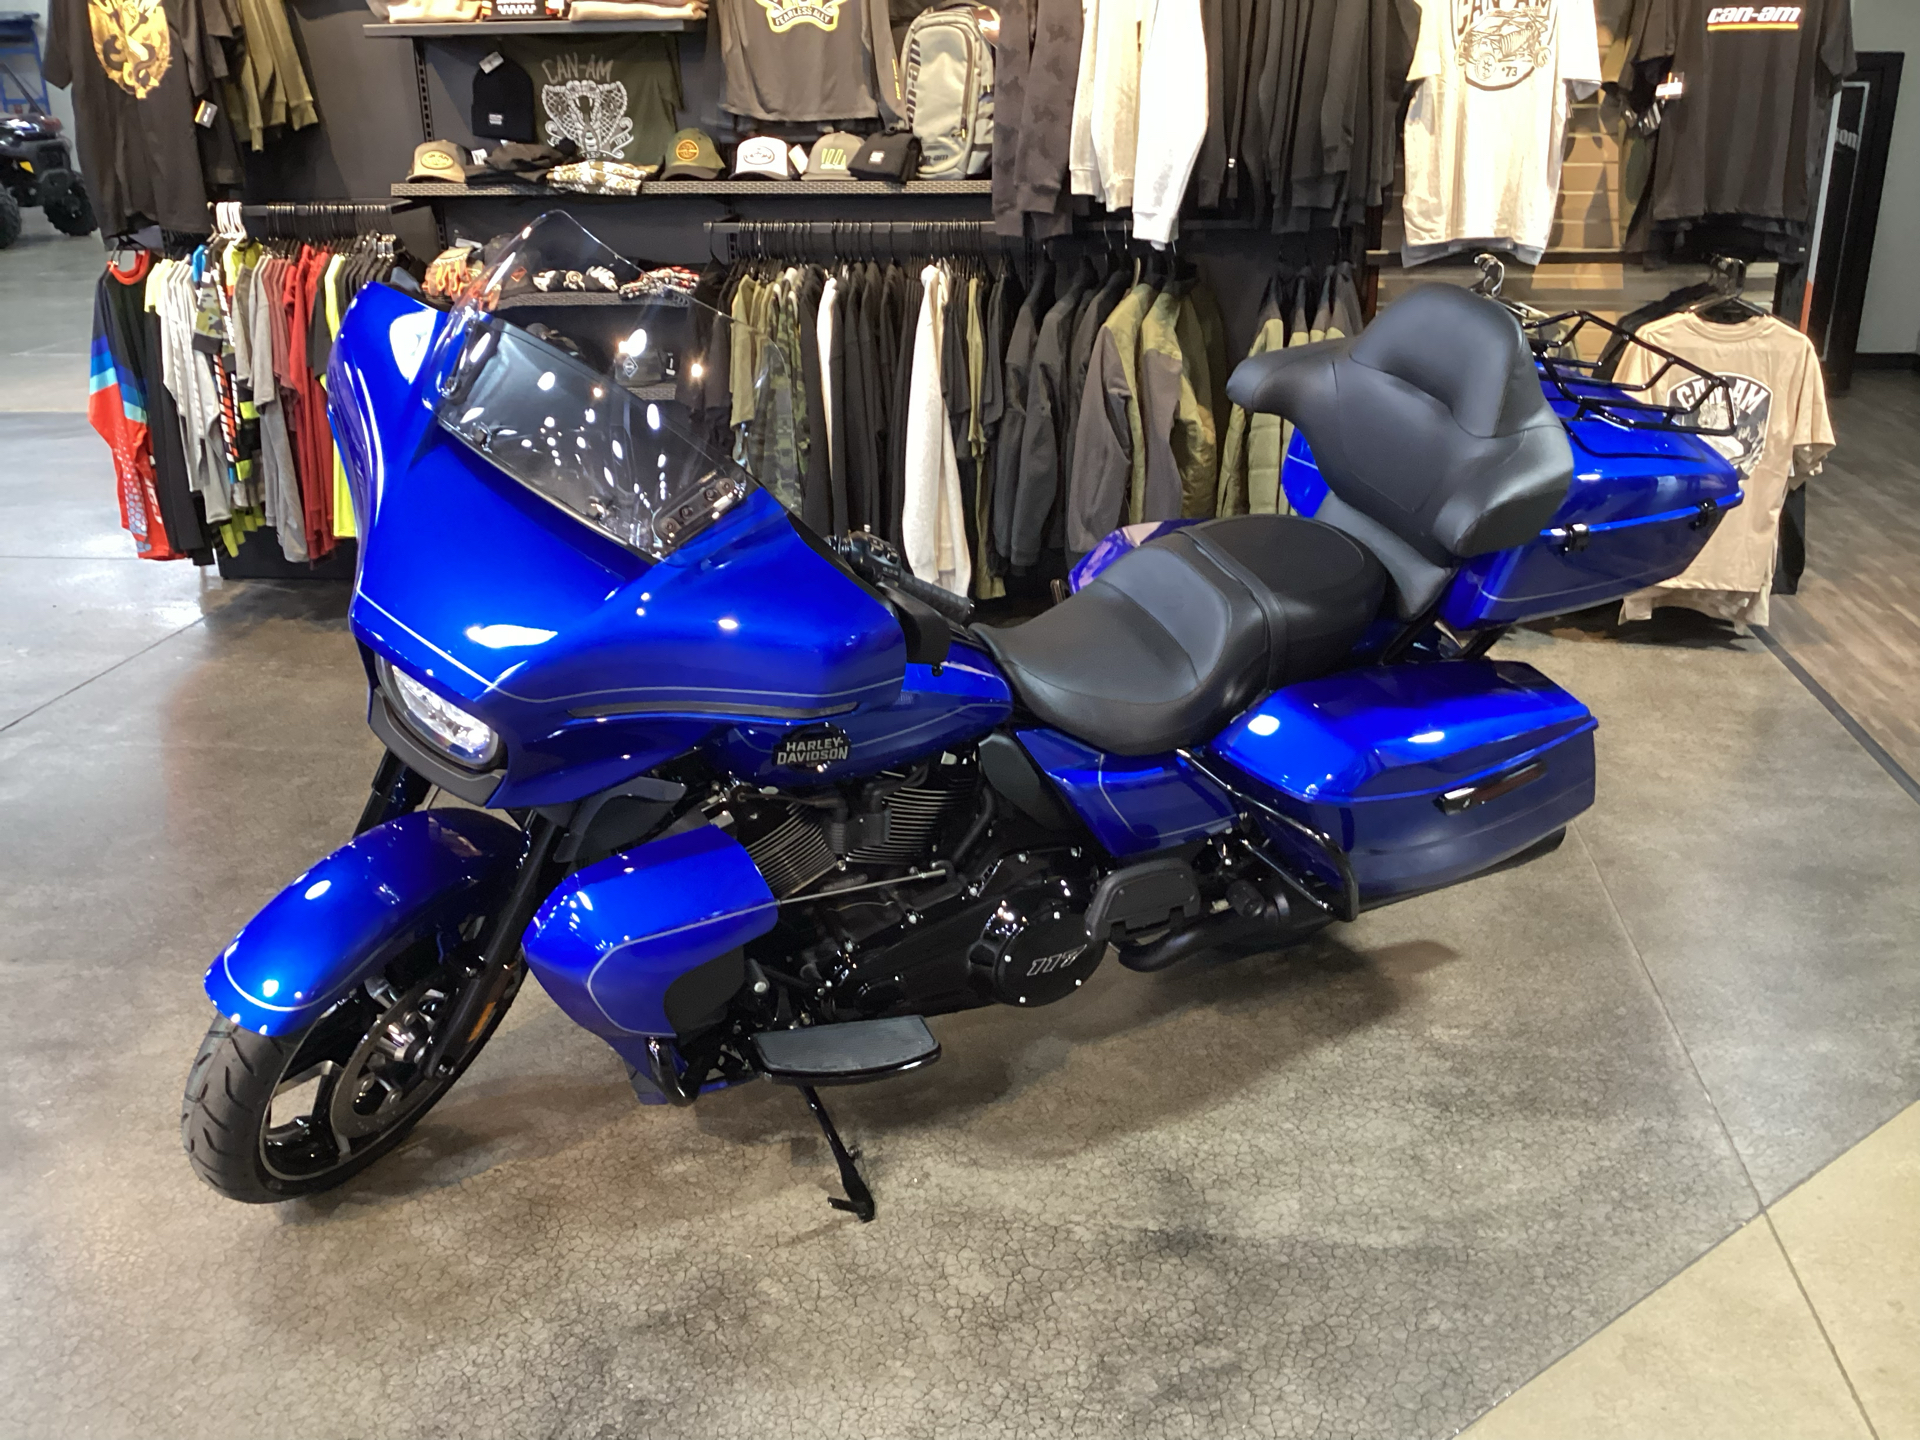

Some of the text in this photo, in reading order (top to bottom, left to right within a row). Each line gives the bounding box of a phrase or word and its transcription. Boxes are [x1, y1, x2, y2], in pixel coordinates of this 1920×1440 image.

[775, 7, 812, 26] FEARLESS
[1707, 6, 1801, 23] can-am
[541, 51, 614, 84] CAN-AM
[906, 38, 921, 124] an-am
[776, 746, 849, 766] DAVIDSON
